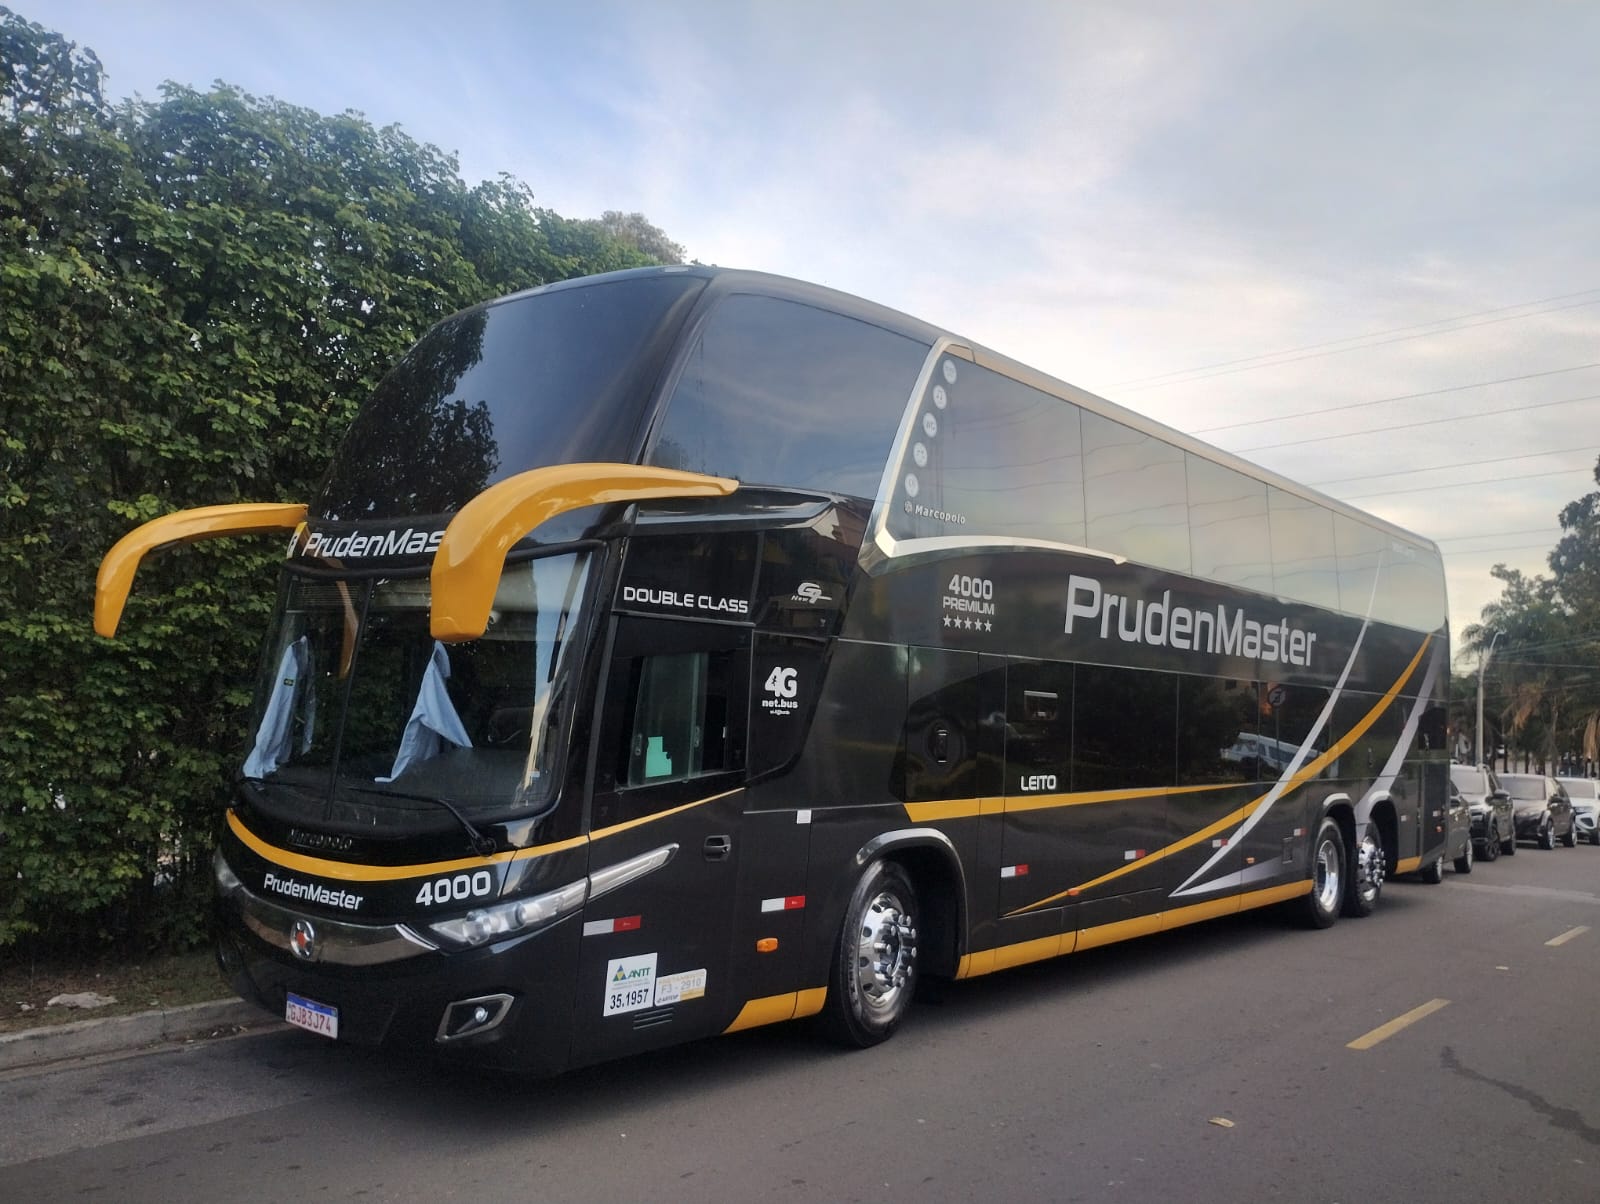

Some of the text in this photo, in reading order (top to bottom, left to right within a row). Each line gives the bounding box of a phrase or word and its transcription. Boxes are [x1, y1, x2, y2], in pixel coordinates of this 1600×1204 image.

[915, 504, 966, 524] Marcopolo
[301, 528, 447, 558] PrudenMas
[623, 586, 748, 614] DOUBLE CLASS
[948, 574, 993, 600] 4000
[942, 595, 995, 615] PREMIUM
[1064, 574, 1317, 667] PrudenMaster
[764, 666, 798, 698] 4G
[762, 699, 798, 708] net.bus
[1020, 775, 1057, 791] LEITO
[263, 873, 363, 911] PrudenMaster
[415, 870, 492, 906] 4000
[627, 967, 651, 979] ANTT
[609, 988, 649, 1010] 35.1957
